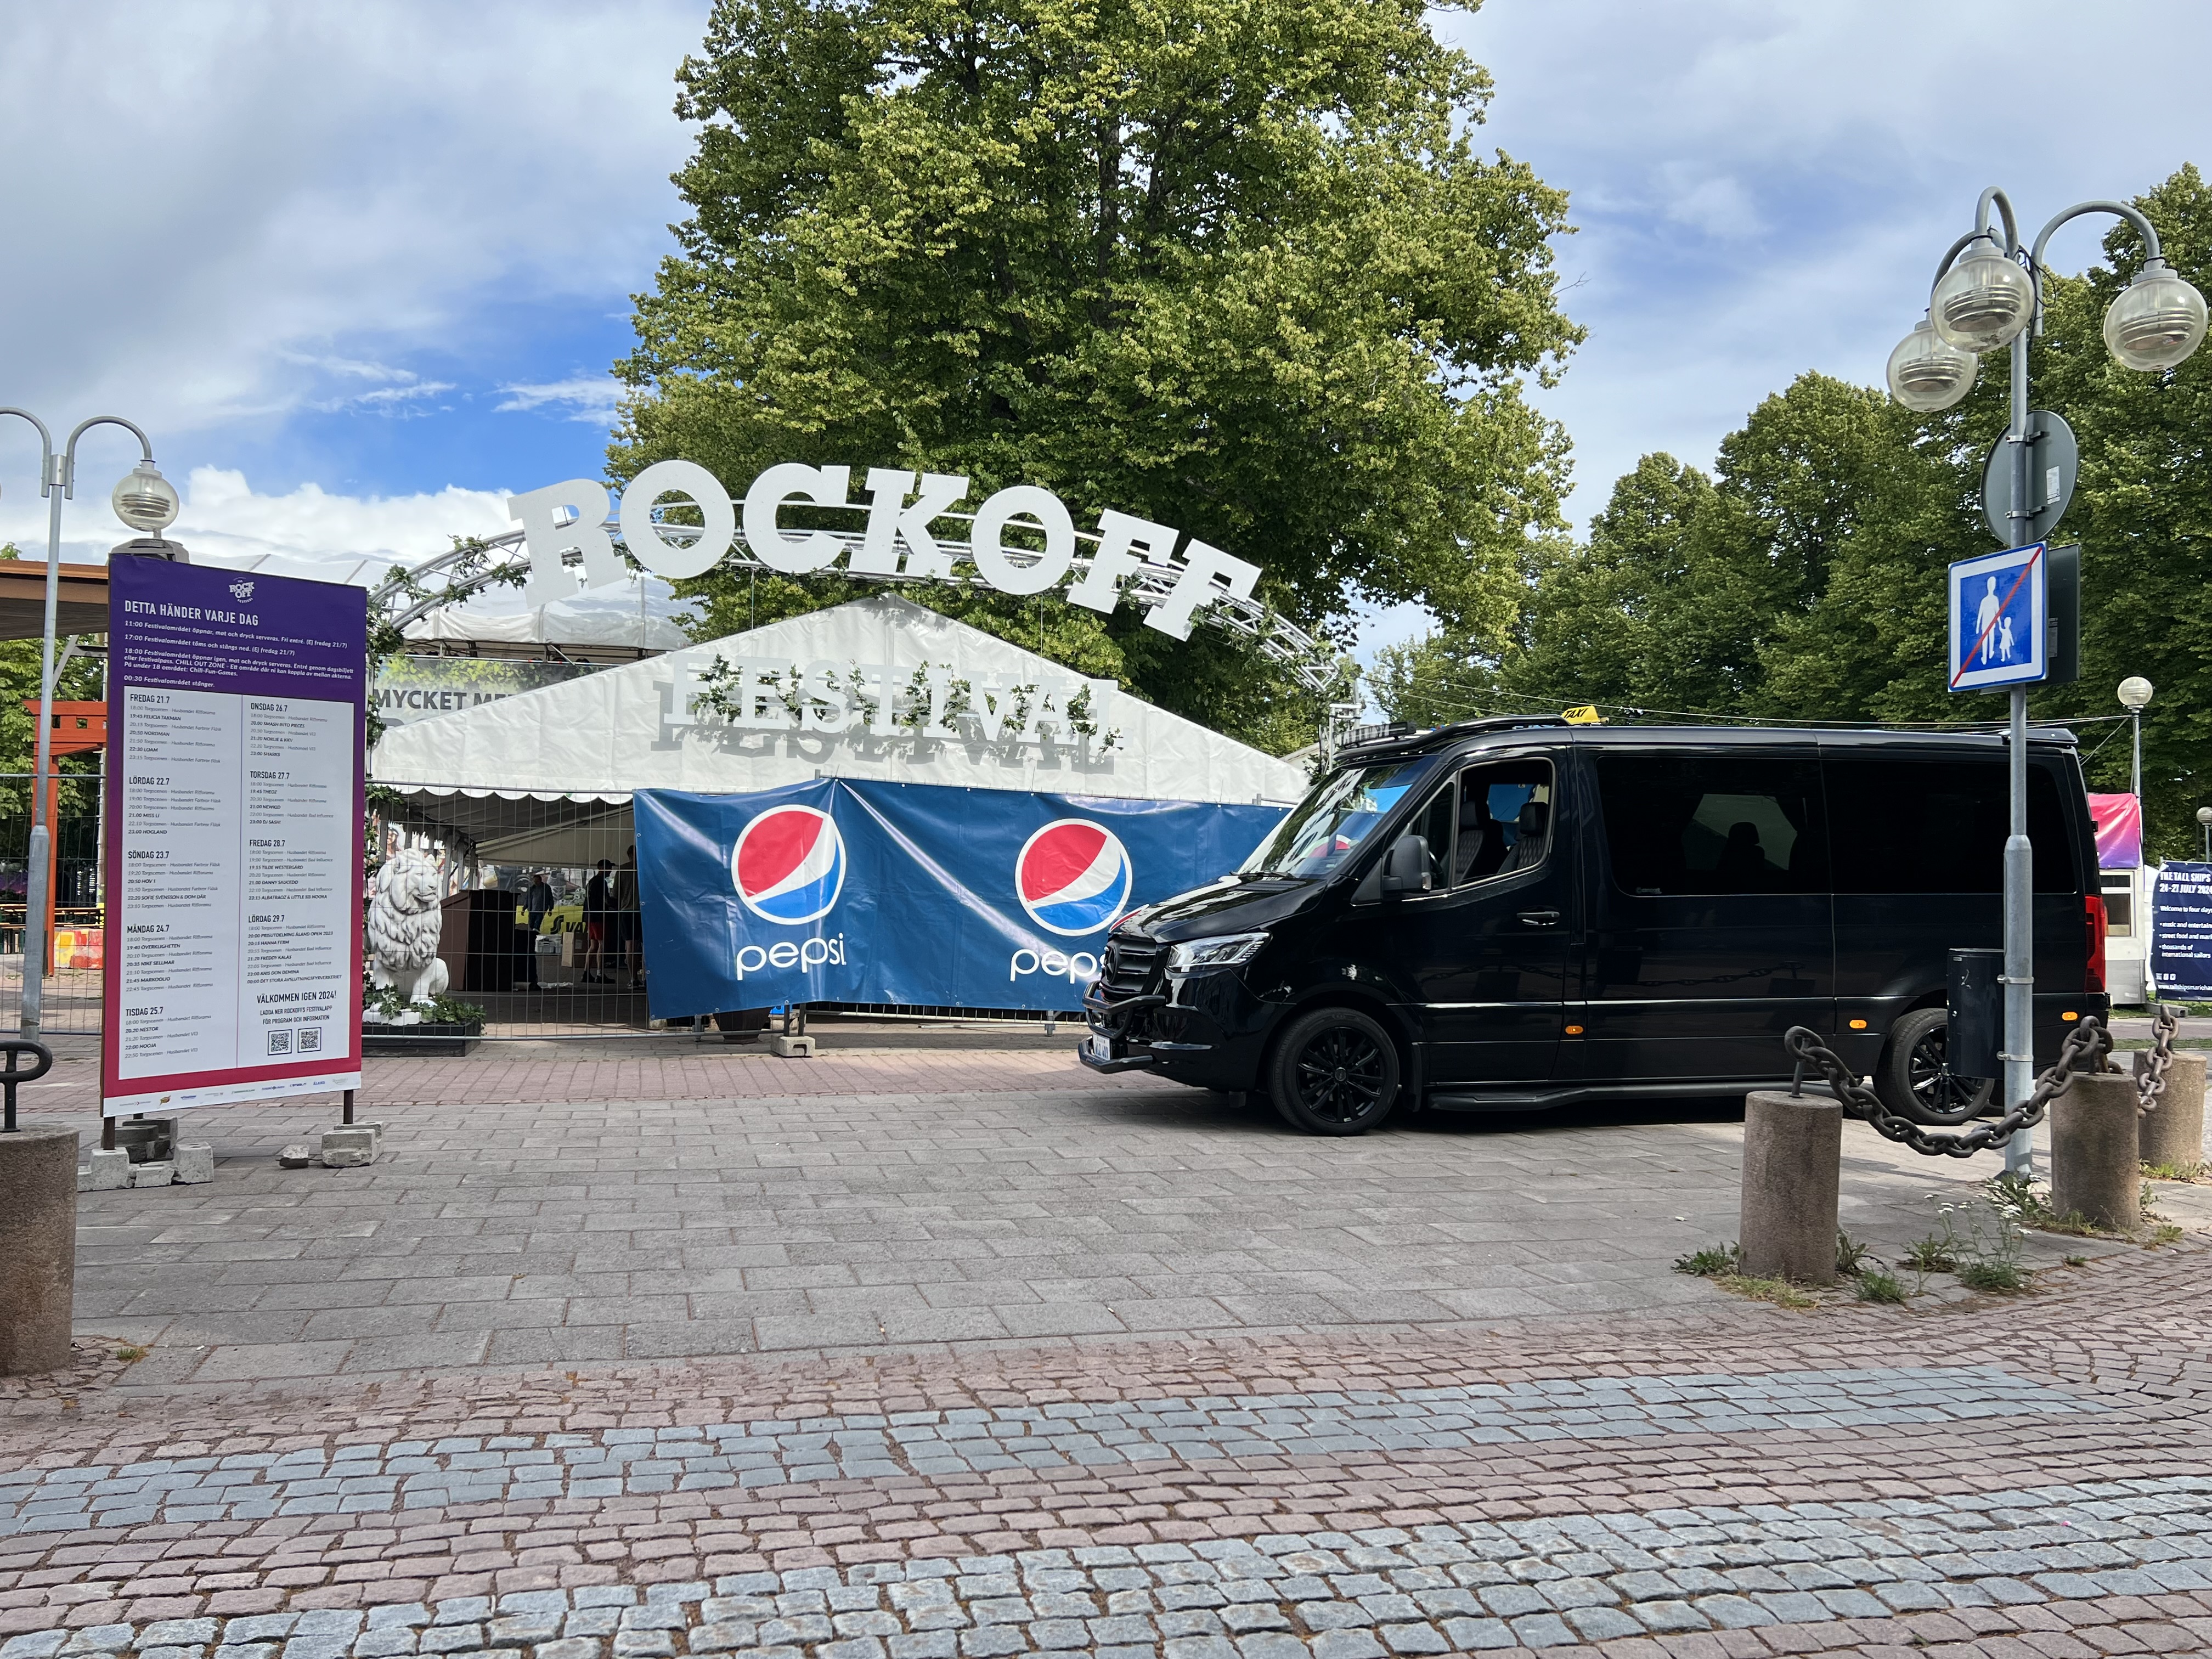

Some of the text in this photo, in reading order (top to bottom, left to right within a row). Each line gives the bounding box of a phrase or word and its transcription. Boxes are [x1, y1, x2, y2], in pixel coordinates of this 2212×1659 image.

[507, 459, 1261, 642] ROCKOFF
[125, 600, 259, 626] DETTA HÄNDER VARJE DAG
[144, 623, 191, 633] Festivalområdet
[144, 636, 191, 646] Festivalområdet
[144, 677, 190, 685] Festivalområdet
[130, 694, 170, 704] FREDAG 21.7
[373, 689, 467, 710] MYCKET
[663, 651, 1133, 749] FESTIVAL
[251, 703, 274, 711] ONSDAG
[1564, 708, 1589, 719] TAXI
[250, 771, 276, 779] TORSDAG
[129, 776, 155, 785] LÖRDAG
[128, 850, 154, 859] SÖNDAG
[2173, 872, 2190, 882] TALL
[2191, 873, 2211, 882] SHIPS
[2180, 884, 2197, 893] JULY
[248, 914, 271, 923] LÖRDAG
[127, 924, 155, 933] MÅNDAG
[736, 932, 847, 981] pepsi
[1010, 949, 1105, 984] pep
[257, 990, 337, 1003] VÄLKOMMEN IGEN 2024!
[126, 1007, 163, 1016] TISDAG 25.7
